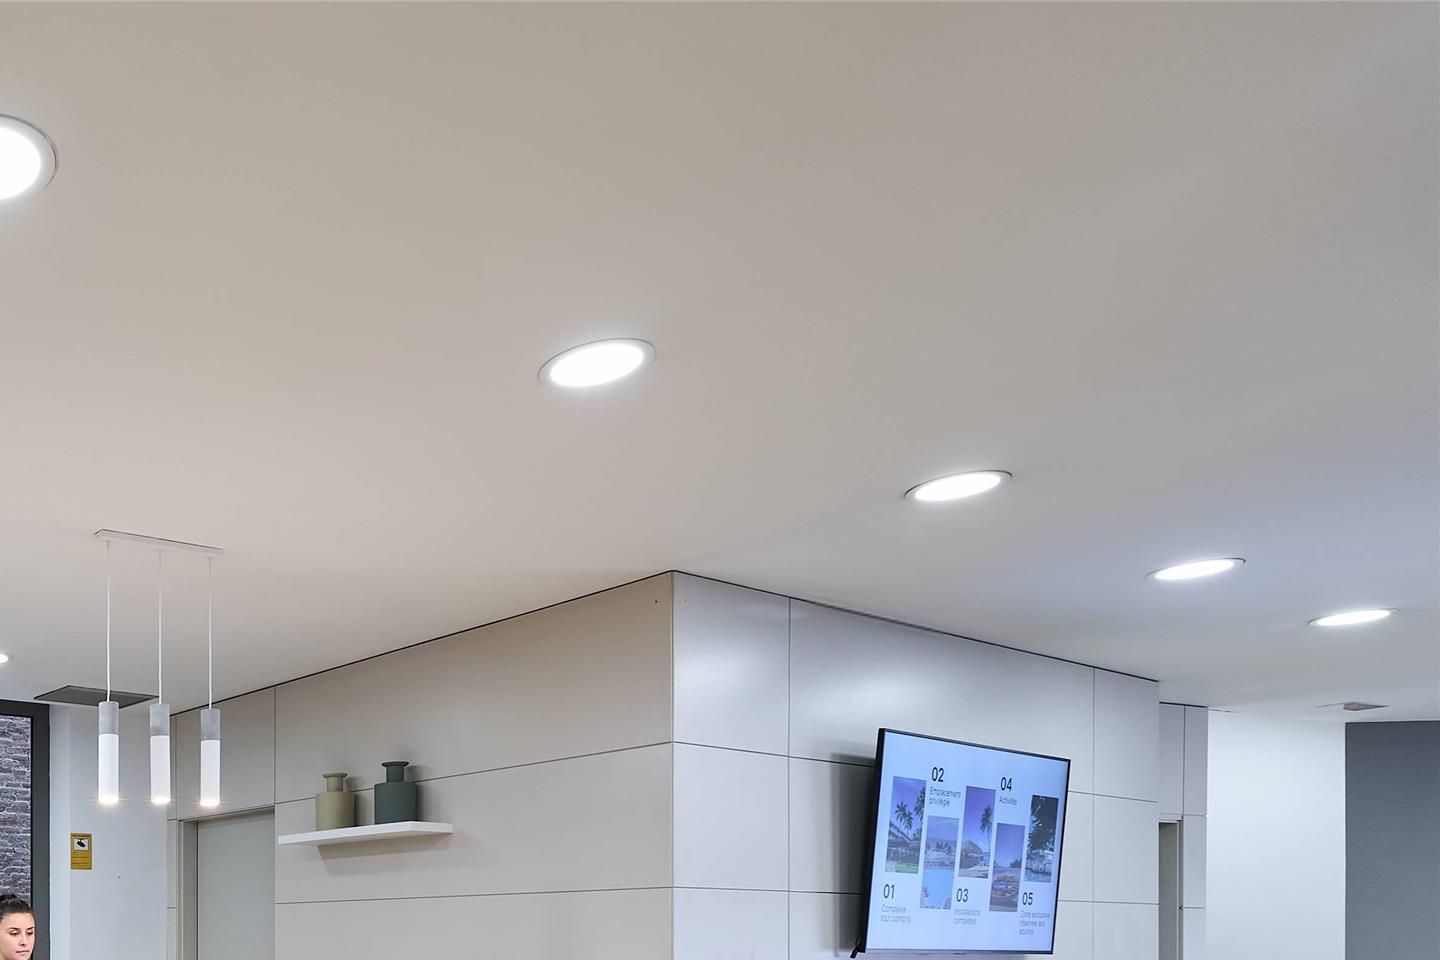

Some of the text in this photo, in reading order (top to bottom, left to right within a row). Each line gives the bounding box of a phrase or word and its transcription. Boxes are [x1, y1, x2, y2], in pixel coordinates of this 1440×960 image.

[931, 767, 944, 782] 02
[1000, 777, 1012, 791] 04
[929, 786, 962, 798] Emplacement
[883, 884, 895, 899] 01
[956, 888, 969, 902] 03
[1022, 892, 1033, 906] 05
